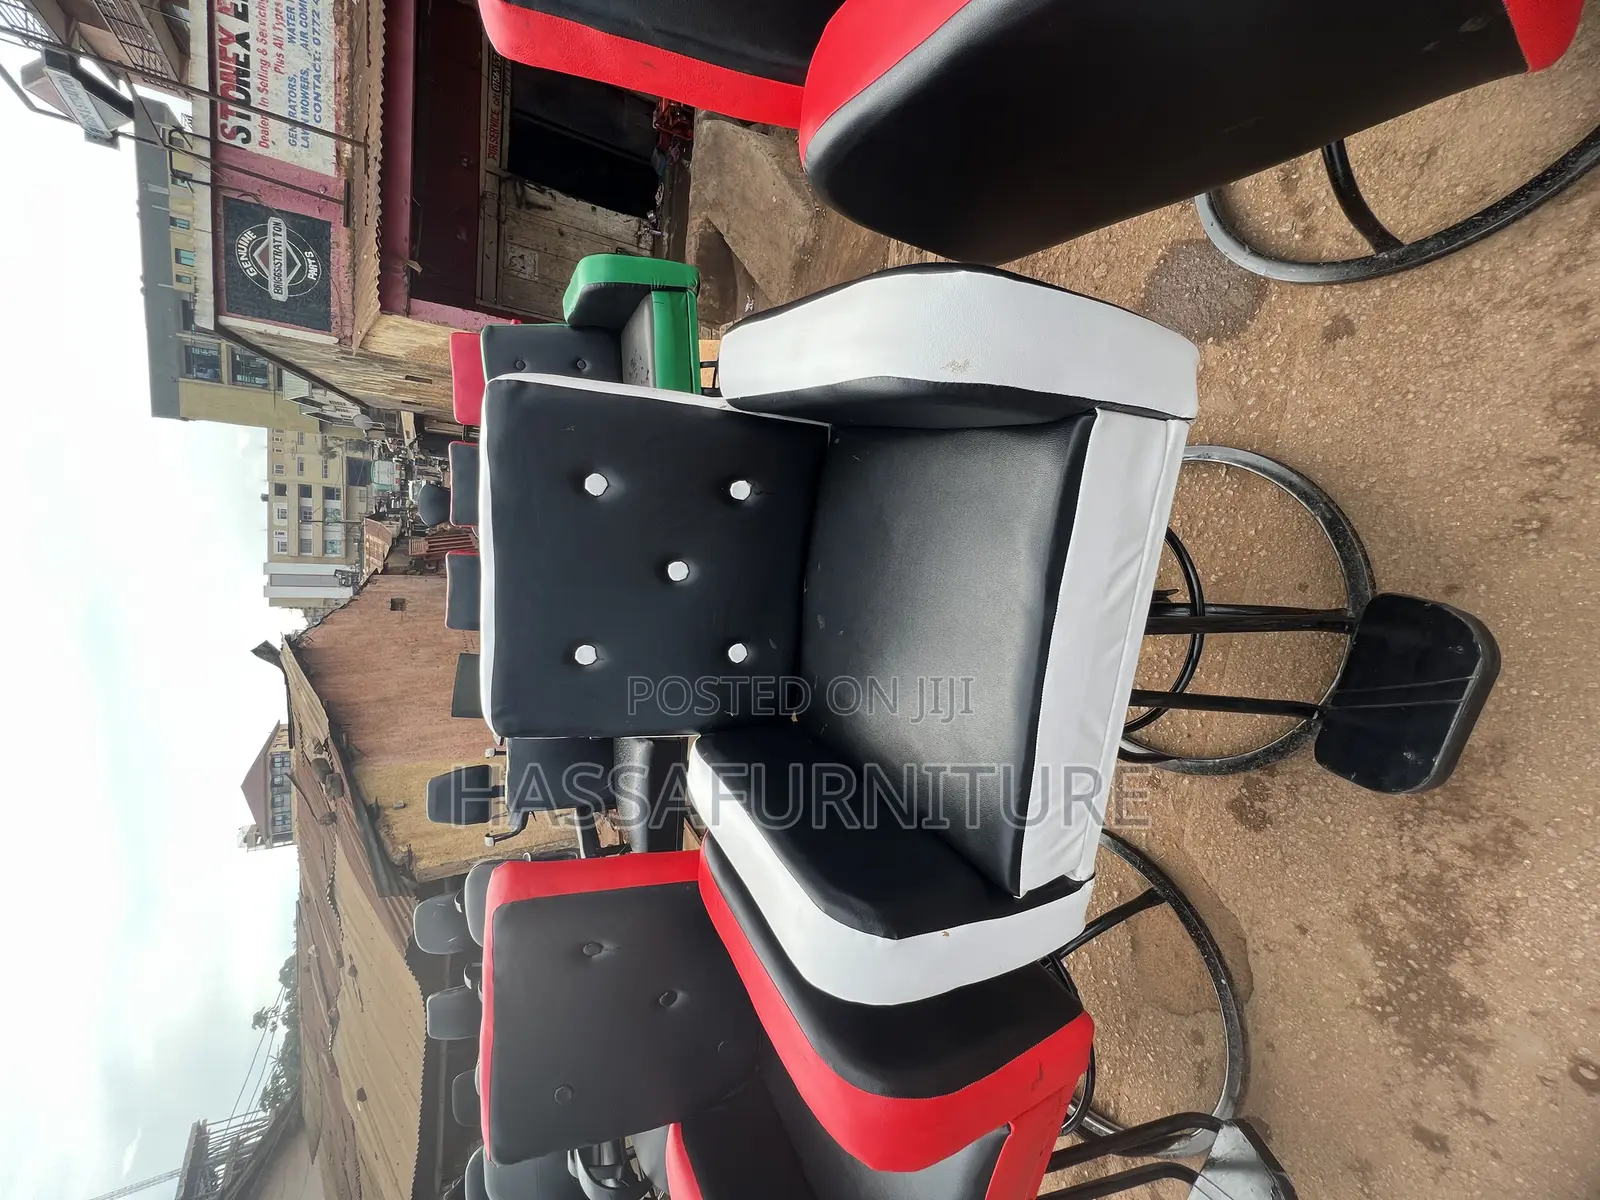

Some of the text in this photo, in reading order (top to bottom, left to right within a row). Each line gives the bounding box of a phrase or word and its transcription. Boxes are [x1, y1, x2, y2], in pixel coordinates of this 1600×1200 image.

[273, 3, 286, 75] Plus All Types
[286, 6, 297, 44] WATER
[300, 31, 309, 51] AIR
[312, 10, 321, 46] 0772
[257, 48, 267, 56] &
[218, 25, 251, 145] STONEX
[257, 58, 270, 94] Selling
[300, 67, 310, 116] MOWERS,
[313, 51, 322, 123] CONTACT:
[259, 98, 268, 107] In
[287, 74, 298, 147] GENRATORS,
[489, 108, 500, 144] SERVICE
[237, 230, 258, 277] GENUINE
[305, 251, 317, 280] PARTS
